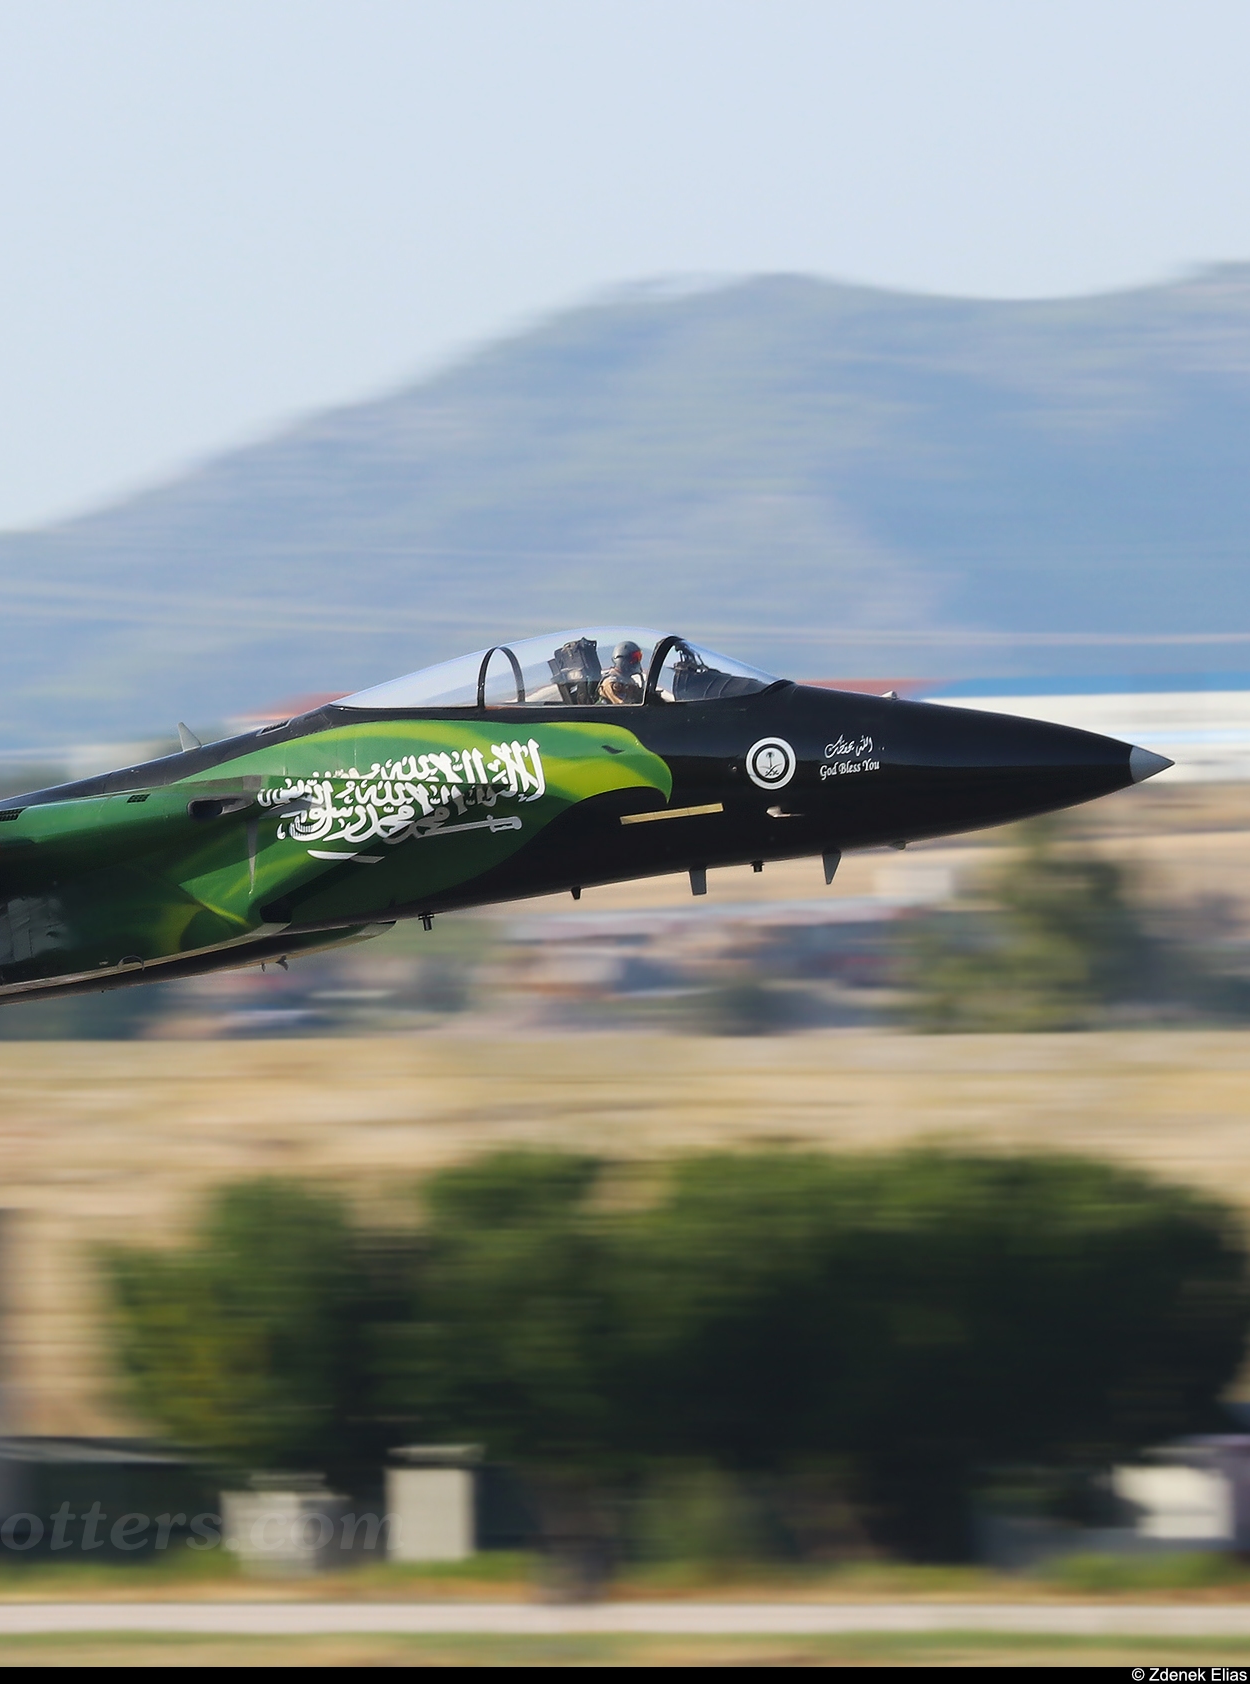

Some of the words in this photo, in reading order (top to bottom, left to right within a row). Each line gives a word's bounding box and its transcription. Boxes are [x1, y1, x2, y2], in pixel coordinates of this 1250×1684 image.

[819, 762, 839, 781] God
[839, 760, 862, 775] Bless
[862, 758, 880, 772] You
